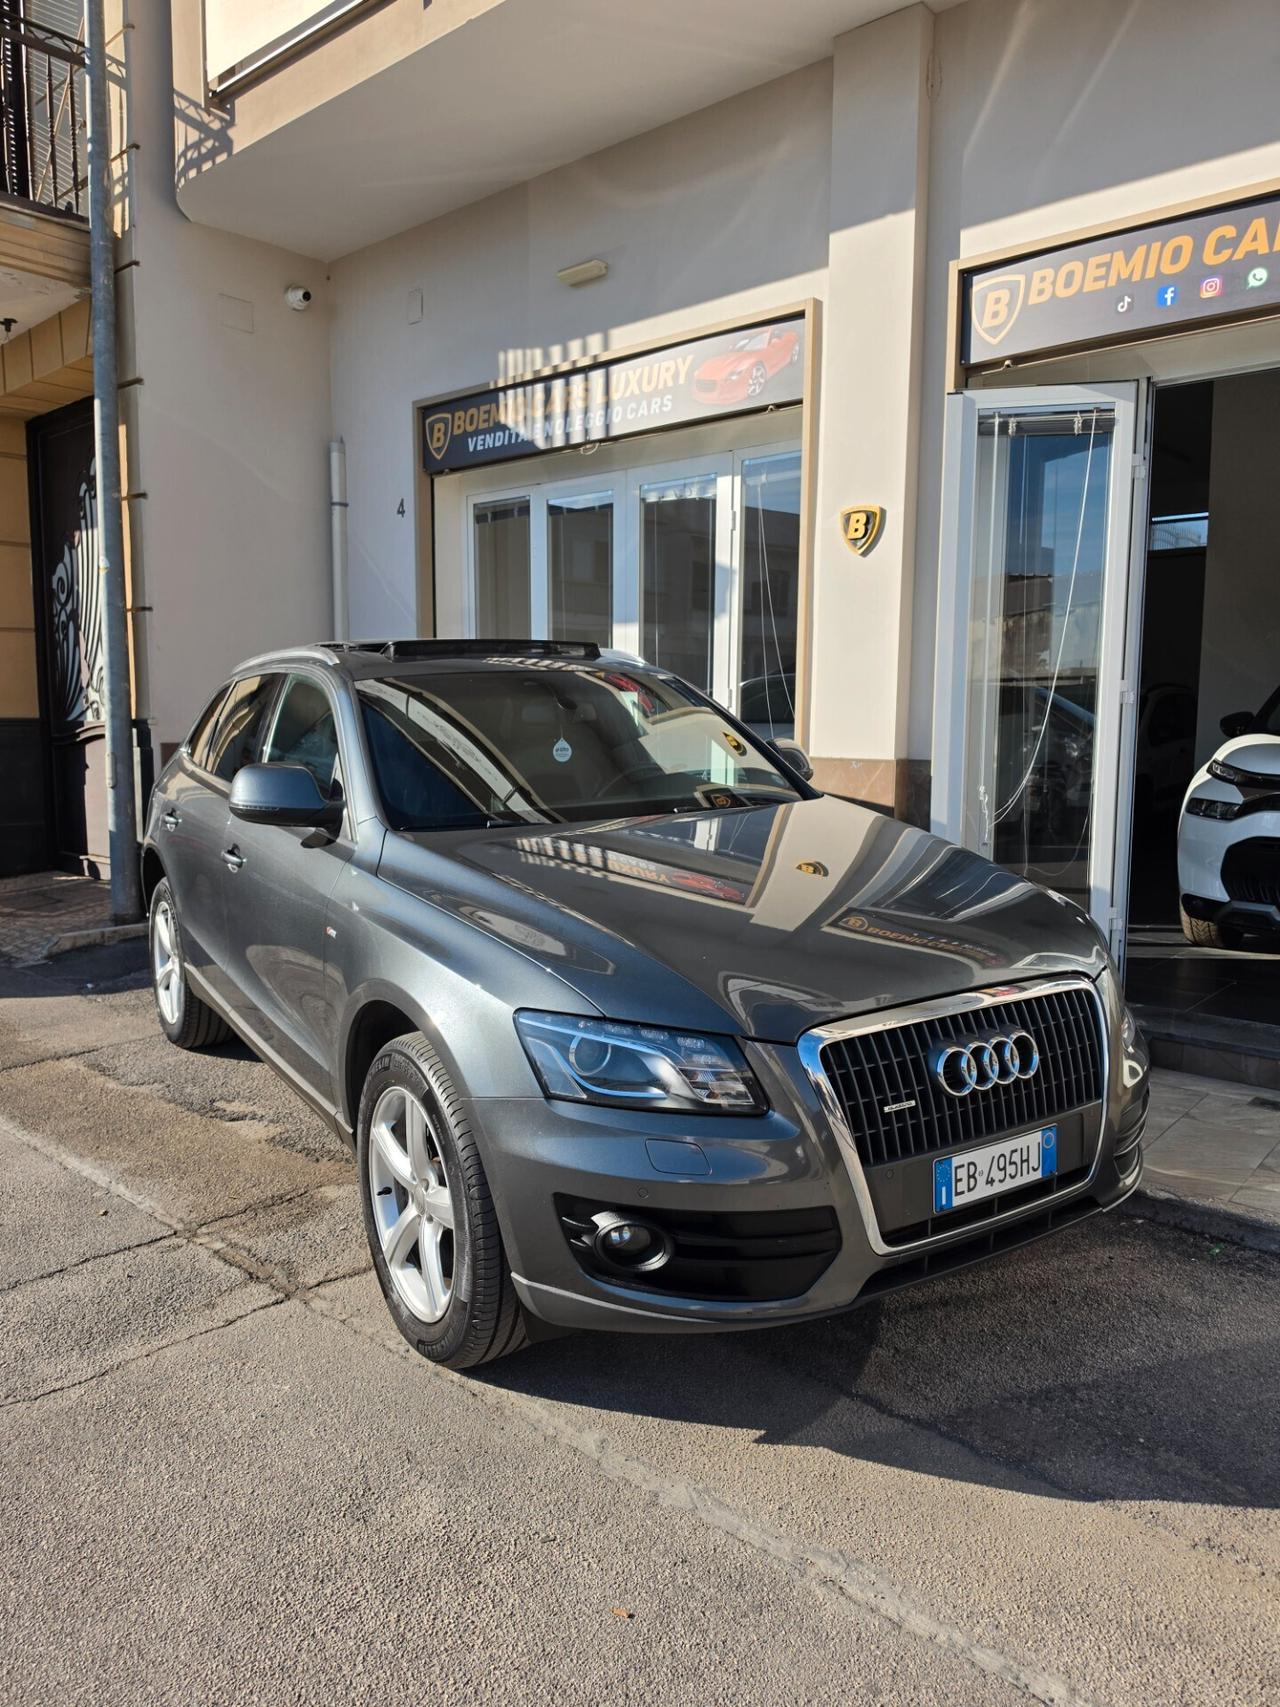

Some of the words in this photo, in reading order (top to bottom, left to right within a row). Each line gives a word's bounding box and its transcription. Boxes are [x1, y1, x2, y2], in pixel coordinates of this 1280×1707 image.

[1027, 235, 1194, 306] BOEMIO
[982, 288, 1010, 329] B
[595, 354, 694, 405] LUXURY
[432, 422, 445, 449] B
[467, 425, 529, 452] VENDITA
[626, 395, 673, 420] CARS
[396, 497, 406, 518] 4
[847, 511, 867, 540] B
[954, 1161, 978, 1197] EB
[985, 1142, 1041, 1187] 495HJ
